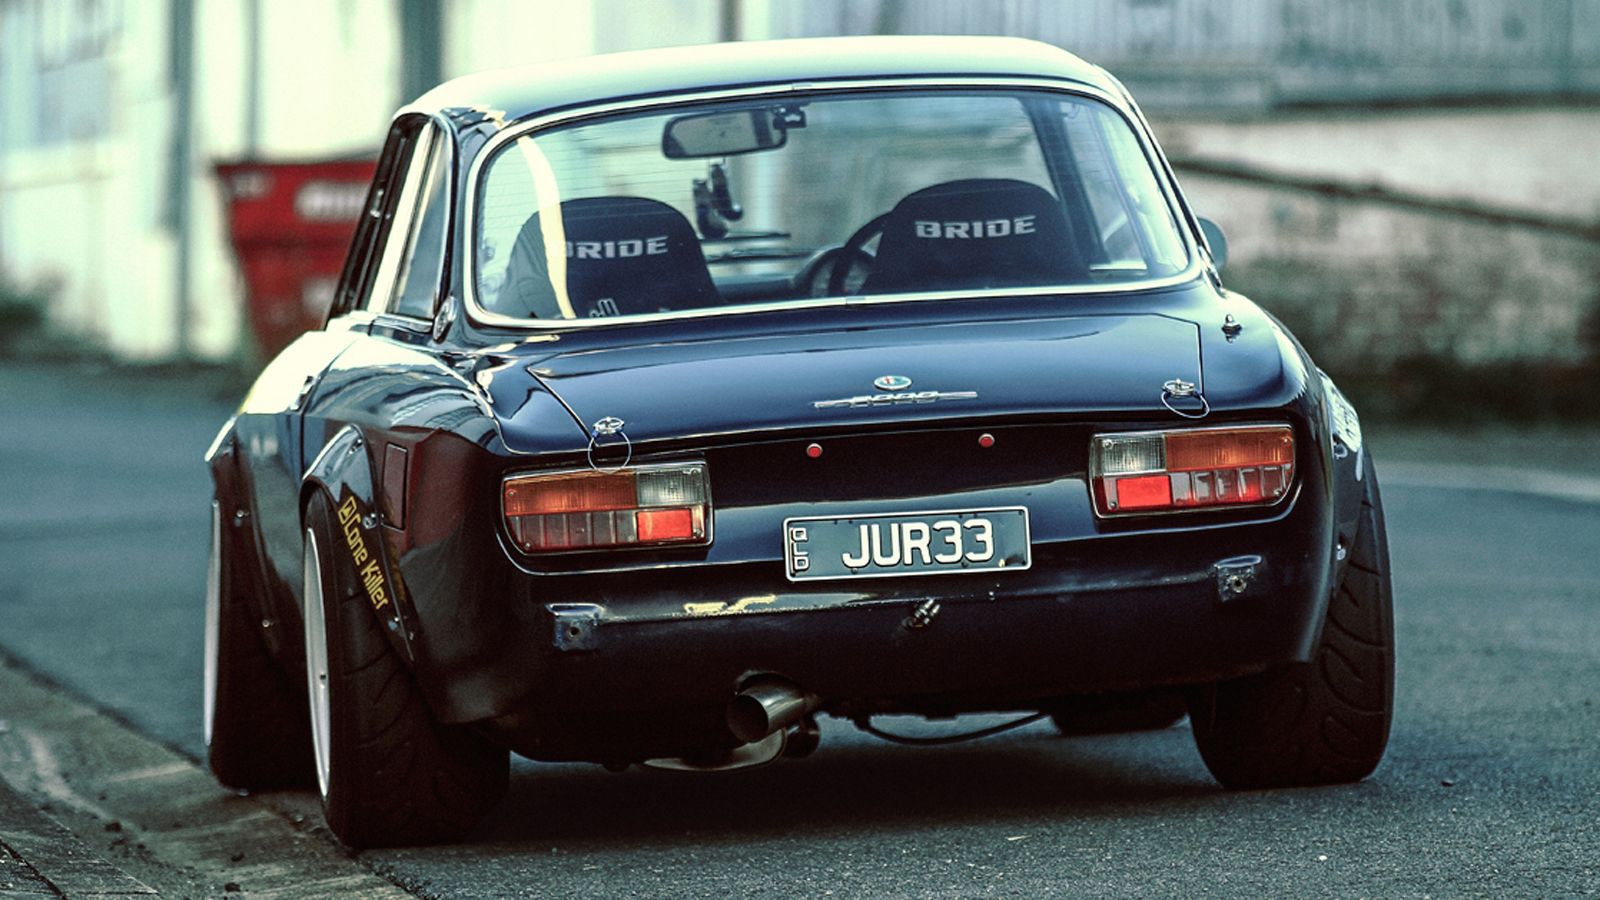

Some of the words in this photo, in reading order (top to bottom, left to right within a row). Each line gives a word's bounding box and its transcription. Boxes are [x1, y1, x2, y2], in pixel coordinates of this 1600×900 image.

[567, 236, 669, 259] RIDE
[915, 215, 1036, 239] BRIDE
[344, 513, 368, 566] Cone
[361, 559, 388, 609] Killer
[791, 527, 810, 571] QLD
[842, 518, 994, 568] JUR33
